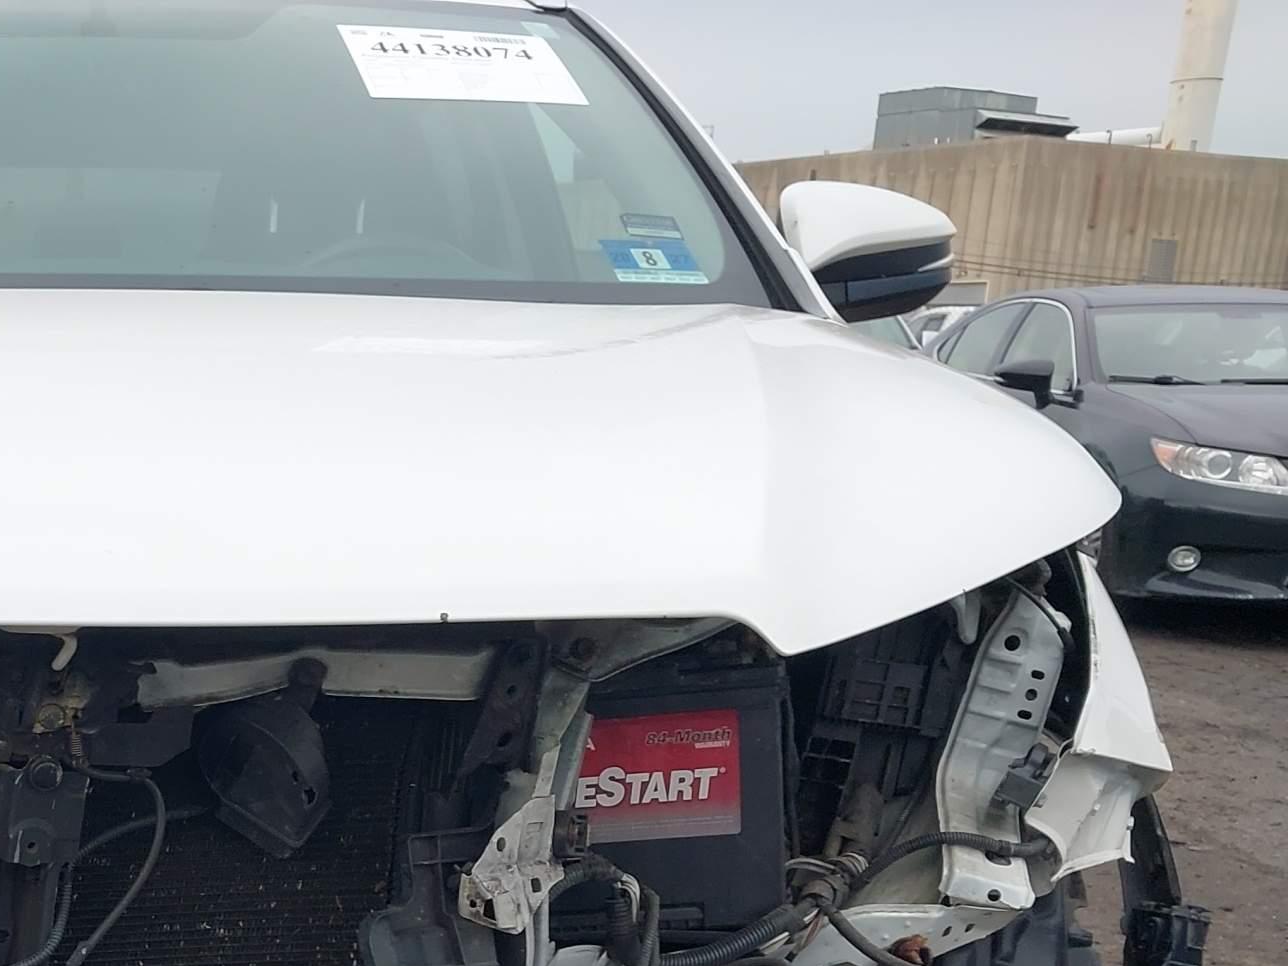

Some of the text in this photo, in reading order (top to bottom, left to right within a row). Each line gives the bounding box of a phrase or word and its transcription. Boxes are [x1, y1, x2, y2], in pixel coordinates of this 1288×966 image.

[370, 41, 534, 61] 44138074
[641, 250, 658, 267] 8
[645, 728, 733, 746] 84-Month
[574, 766, 719, 809] ESTART
